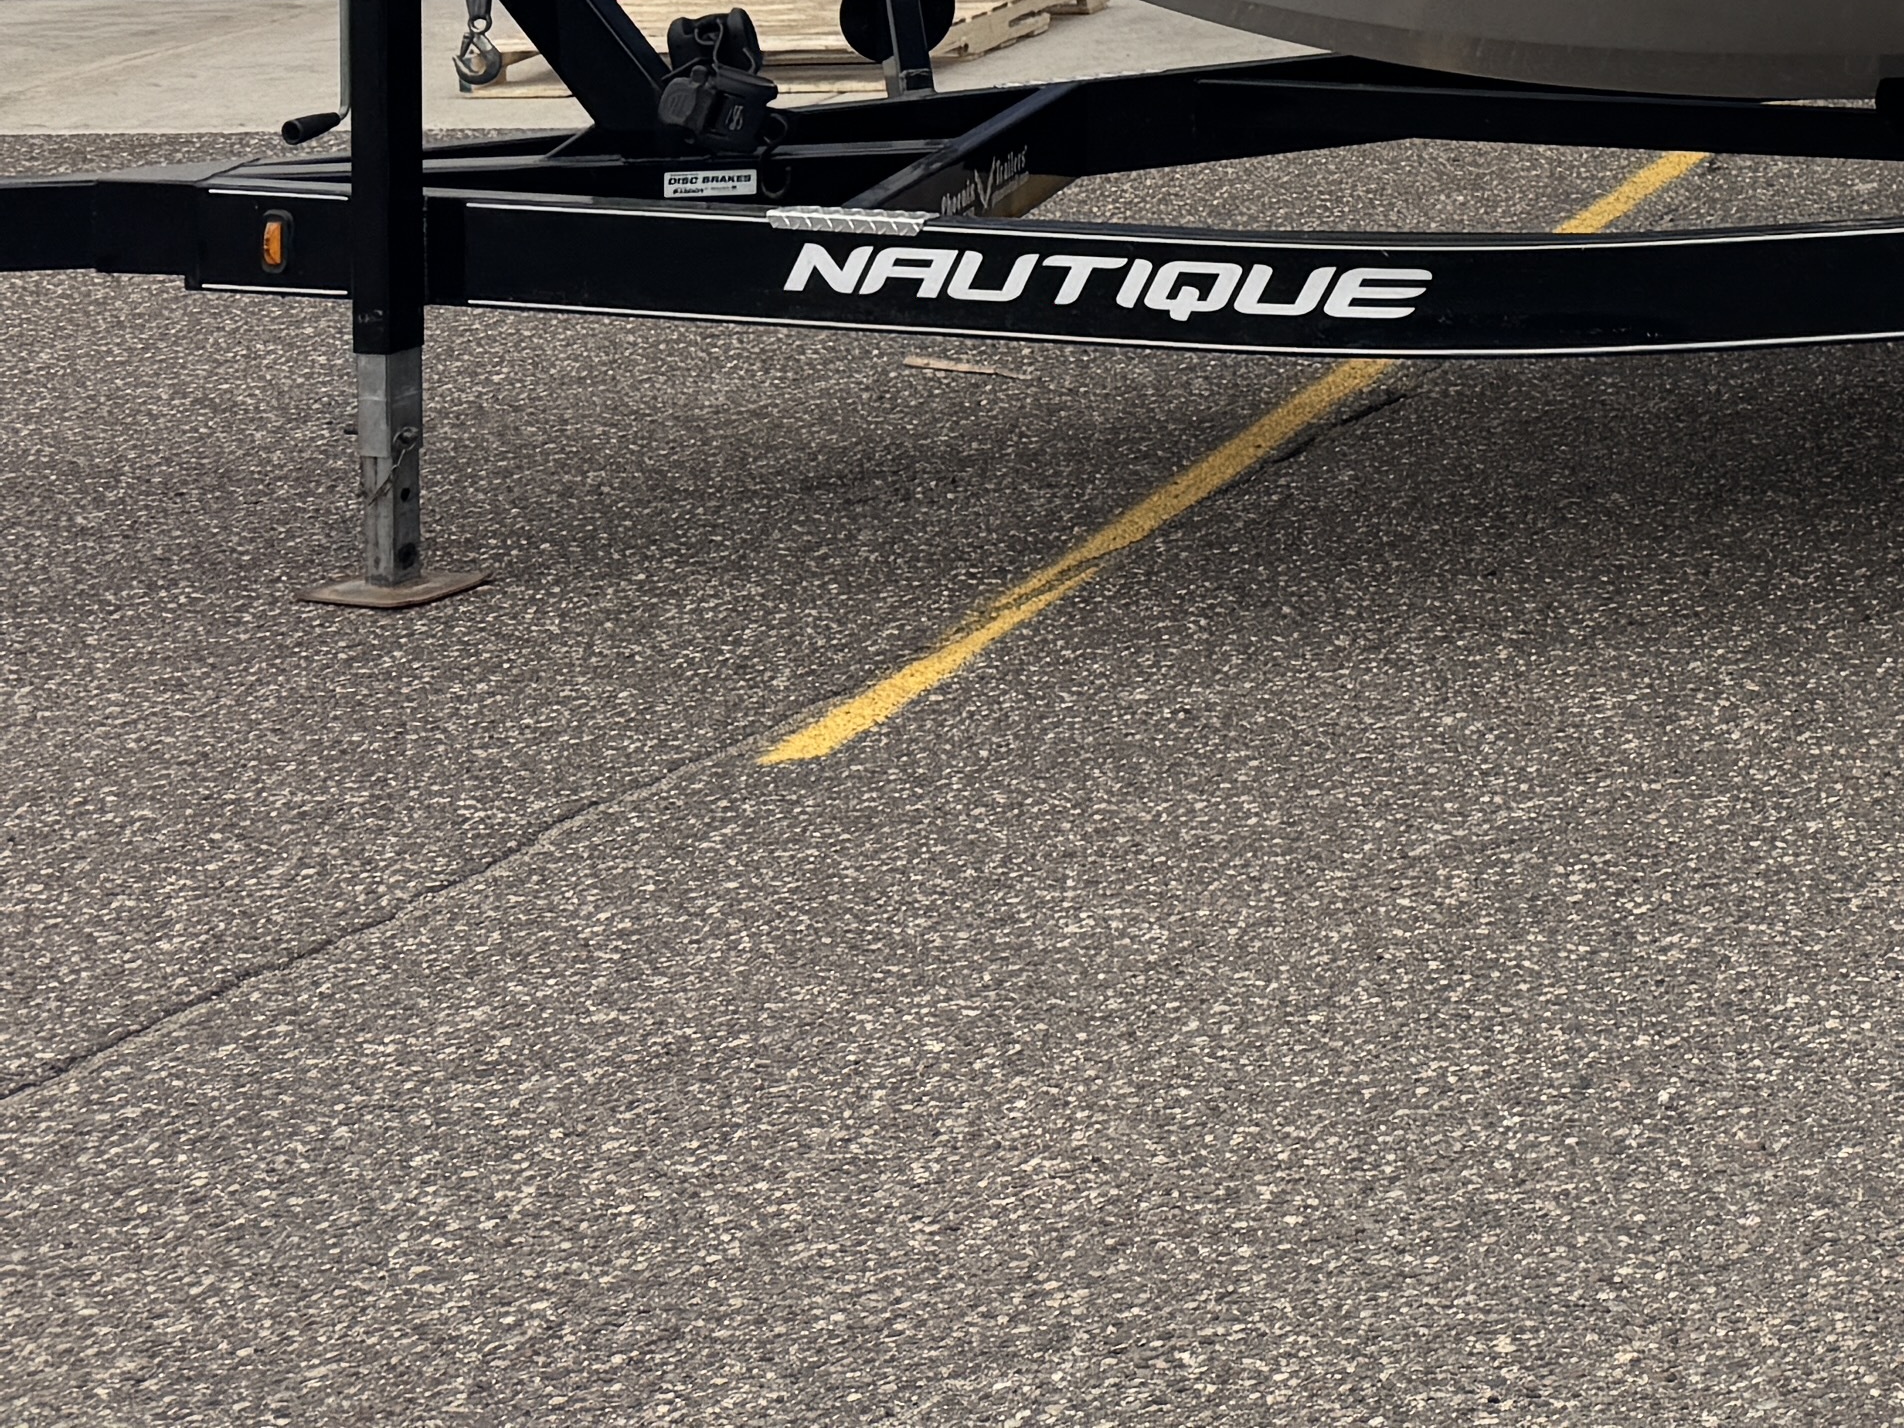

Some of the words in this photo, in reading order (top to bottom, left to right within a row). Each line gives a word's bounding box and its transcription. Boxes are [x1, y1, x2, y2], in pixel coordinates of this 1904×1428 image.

[668, 176, 699, 186] DISC
[702, 174, 752, 184] BRAKES
[783, 242, 1434, 322] NAUTIQUE
